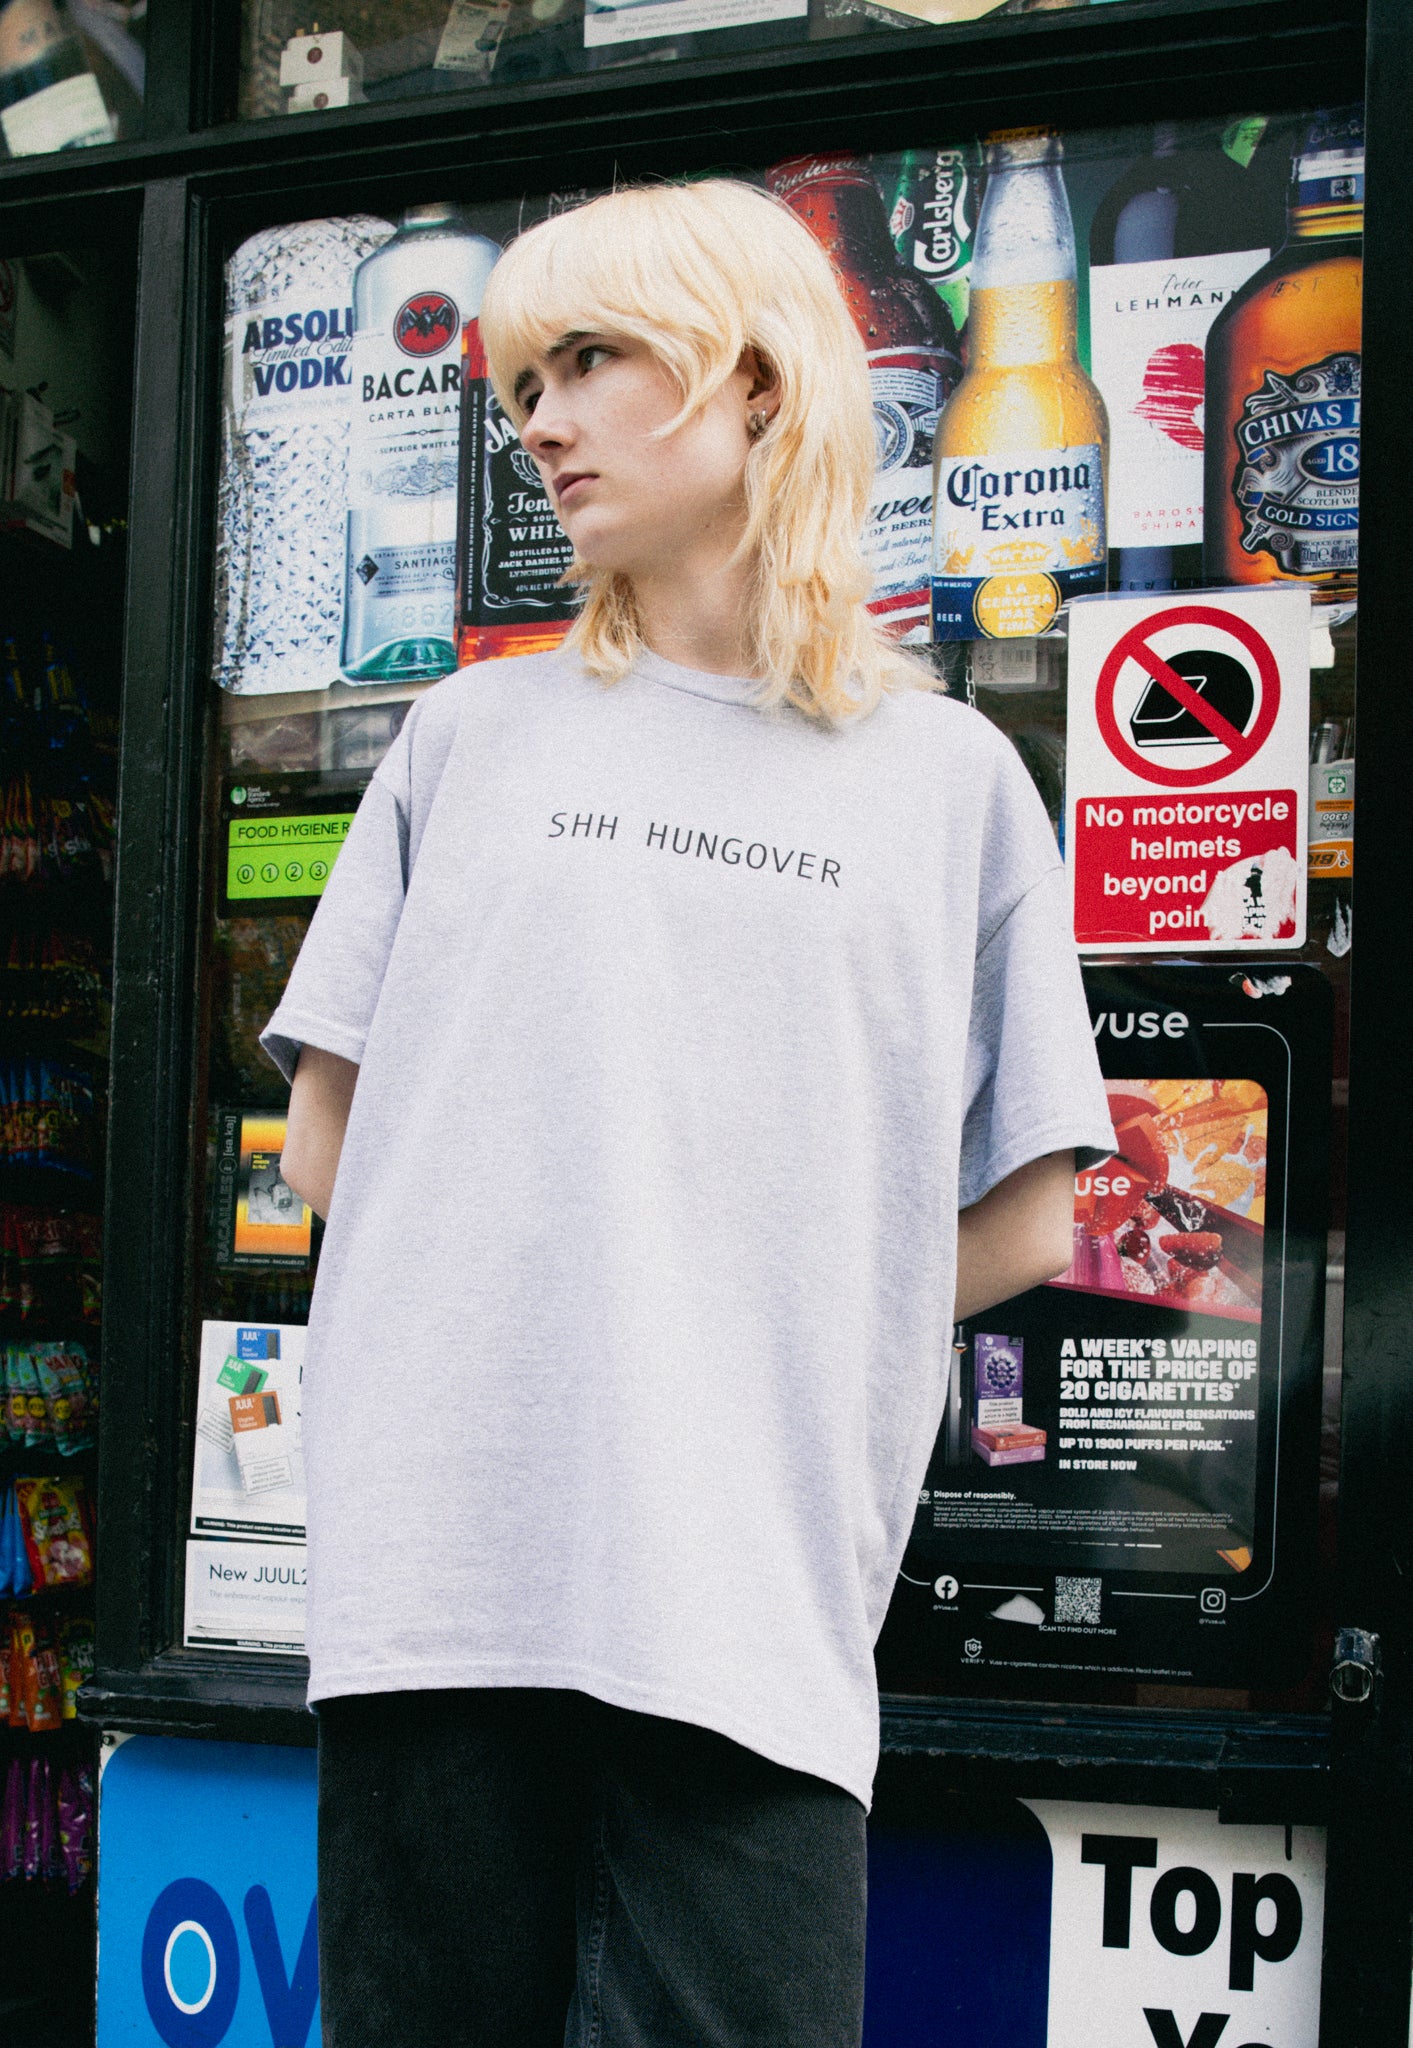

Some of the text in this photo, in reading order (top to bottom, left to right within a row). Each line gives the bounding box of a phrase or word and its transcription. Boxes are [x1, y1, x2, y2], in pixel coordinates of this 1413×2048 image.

[914, 151, 963, 273] Carlsberg
[253, 355, 353, 396] VODK
[369, 409, 415, 423] CARTA
[1245, 404, 1343, 445] CHIVAS
[1323, 443, 1359, 473] 18
[947, 463, 1090, 511] Corona
[1297, 497, 1339, 506] SCOTCH
[981, 505, 1065, 531] Extra
[1265, 506, 1311, 526] GOLD
[498, 560, 523, 568] JACK
[525, 557, 561, 566] DANIEL
[982, 594, 1052, 609] CERVEZA
[937, 613, 962, 622] BEER
[1085, 804, 1124, 827] No
[1133, 798, 1289, 828] motorcycle
[1322, 812, 1349, 821] 2300
[238, 826, 278, 839] FOOD
[282, 822, 339, 837] HYGIENE
[548, 812, 841, 888] SHH HUNGOVER
[1131, 837, 1241, 860] helmets
[1104, 870, 1207, 900] beyond
[1061, 1339, 1257, 1359] A WEEK'S VAPING
[1060, 1359, 1257, 1380] FOR THE PRICE OF
[1060, 1380, 1090, 1400] 20
[1059, 1407, 1256, 1420] BOLD AND ICY FLAVOUR SENSATIONS
[1059, 1419, 1090, 1430] FROM
[1171, 1420, 1205, 1431] EPOD.
[1059, 1438, 1076, 1449] UP
[1077, 1438, 1094, 1450] TO
[1095, 1438, 1124, 1450] 1900
[1125, 1439, 1163, 1451] PUFFS
[1164, 1439, 1189, 1451] PER
[1058, 1459, 1137, 1471] IN STORE NOW
[933, 1490, 1017, 1500] Dispose of responsibly.
[210, 1564, 248, 1581] New
[1038, 1624, 1057, 1632] SCAN
[1098, 1628, 1117, 1636] MORE
[967, 1643, 983, 1651] 18+
[960, 1657, 985, 1665] VERIFY
[1081, 1833, 1303, 1991] Top
